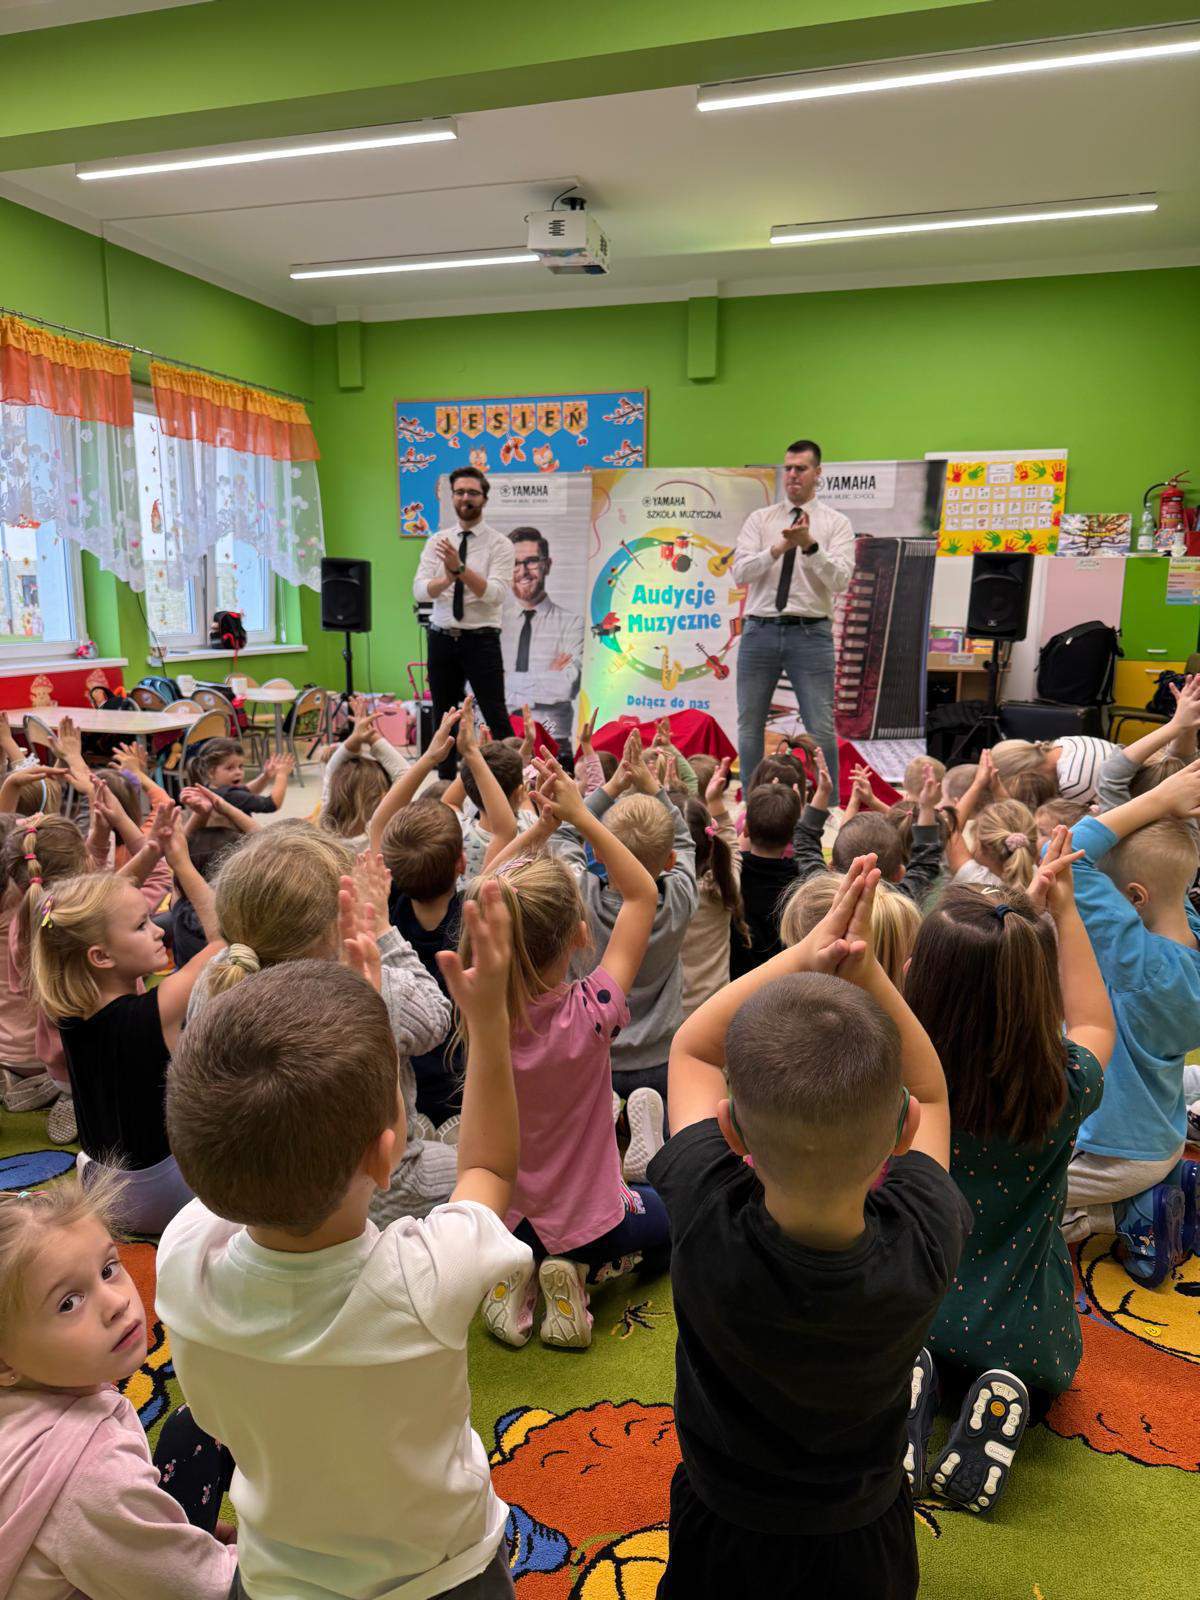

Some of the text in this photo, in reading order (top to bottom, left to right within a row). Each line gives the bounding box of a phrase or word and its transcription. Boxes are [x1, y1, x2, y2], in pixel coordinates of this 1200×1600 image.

[444, 408, 582, 433] JESIEŃ
[827, 475, 876, 490] YAMAHA
[512, 485, 549, 496] YAMAHA
[652, 496, 686, 506] YAMAHA
[679, 510, 722, 519] MUZYCZNA
[631, 578, 715, 609] Audycje
[628, 612, 721, 635] Muzyczne
[627, 695, 710, 709] Dołącz do nas
